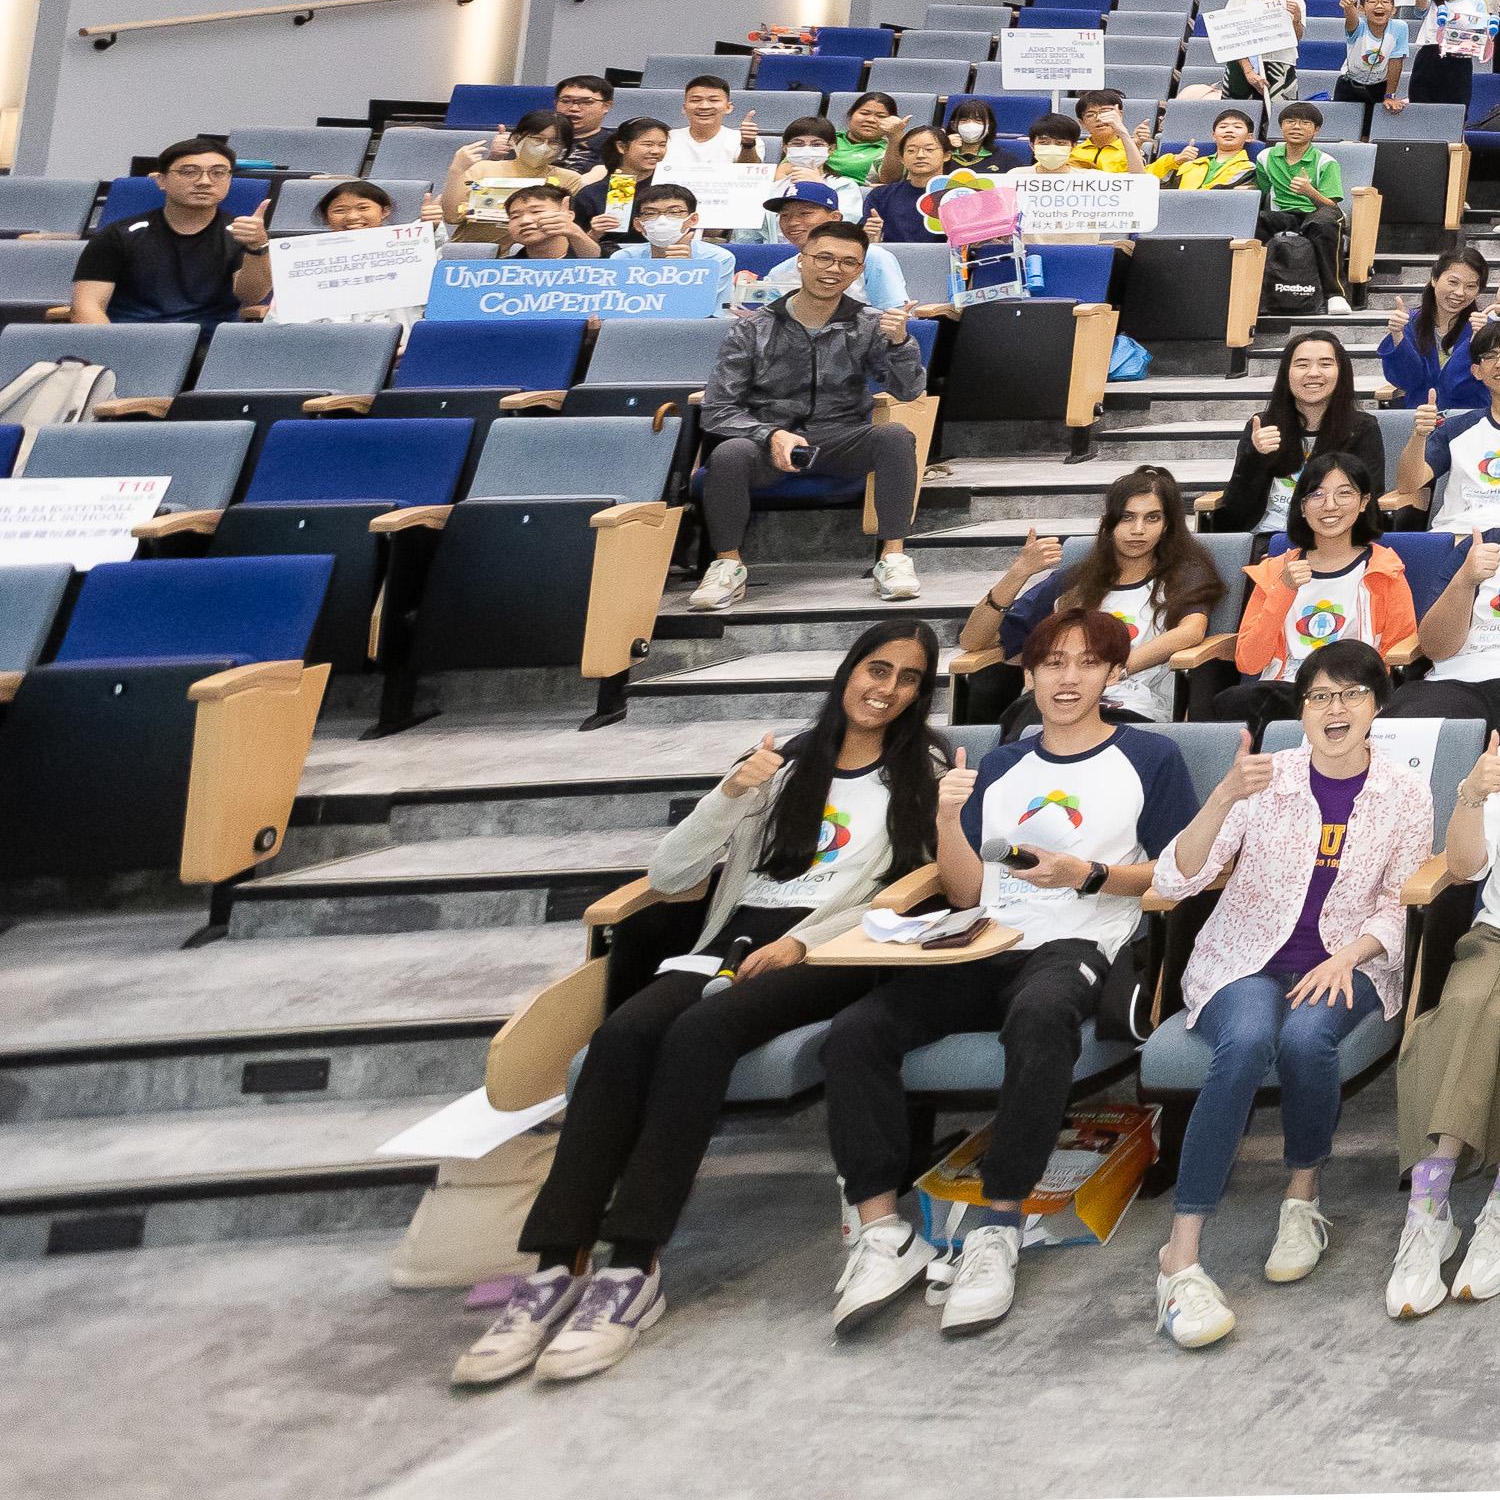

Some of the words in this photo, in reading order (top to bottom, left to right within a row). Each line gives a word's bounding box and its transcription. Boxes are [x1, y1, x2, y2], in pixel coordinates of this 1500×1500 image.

[1077, 32, 1097, 41] T11
[745, 166, 768, 175] T16
[1015, 179, 1135, 192] HSBC/HKUST
[1032, 209, 1069, 218] Youths
[1071, 209, 1134, 220] Programme
[393, 226, 424, 240] T17
[386, 237, 421, 249] Group
[293, 257, 328, 270] SHEK
[329, 255, 351, 267] LEI
[352, 247, 416, 263] CATHOLIC
[288, 260, 365, 279] SECONDARY
[366, 254, 423, 270] SCHOOL
[443, 265, 620, 292] UNDERWATER
[627, 265, 710, 287] ROBOT
[1275, 283, 1316, 293] Reebok
[479, 289, 664, 314] COMPETITION
[441, 401, 447, 409] 7
[117, 480, 156, 494] T18
